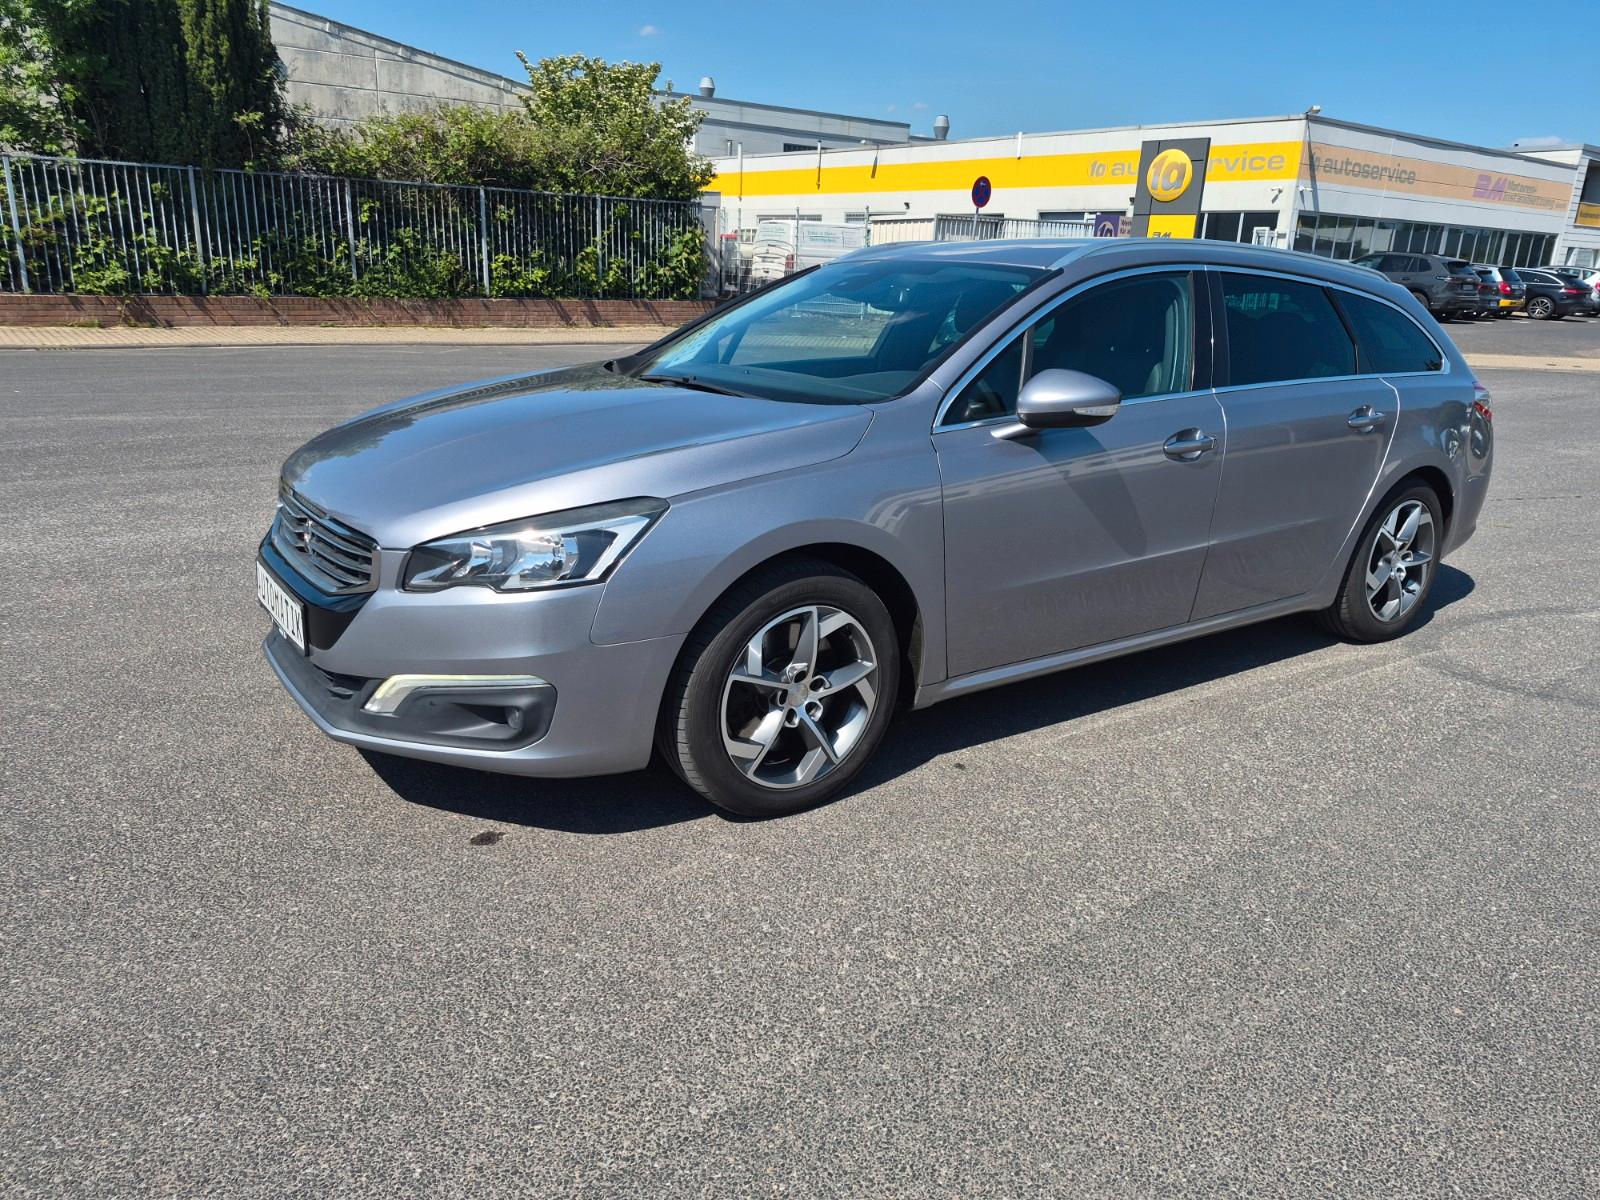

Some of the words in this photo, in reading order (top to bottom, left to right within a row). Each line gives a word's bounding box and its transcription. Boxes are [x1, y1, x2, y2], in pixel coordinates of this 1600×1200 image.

[1111, 151, 1285, 177] aurvice
[1151, 155, 1187, 192] 1a
[1323, 157, 1416, 185] autoservice
